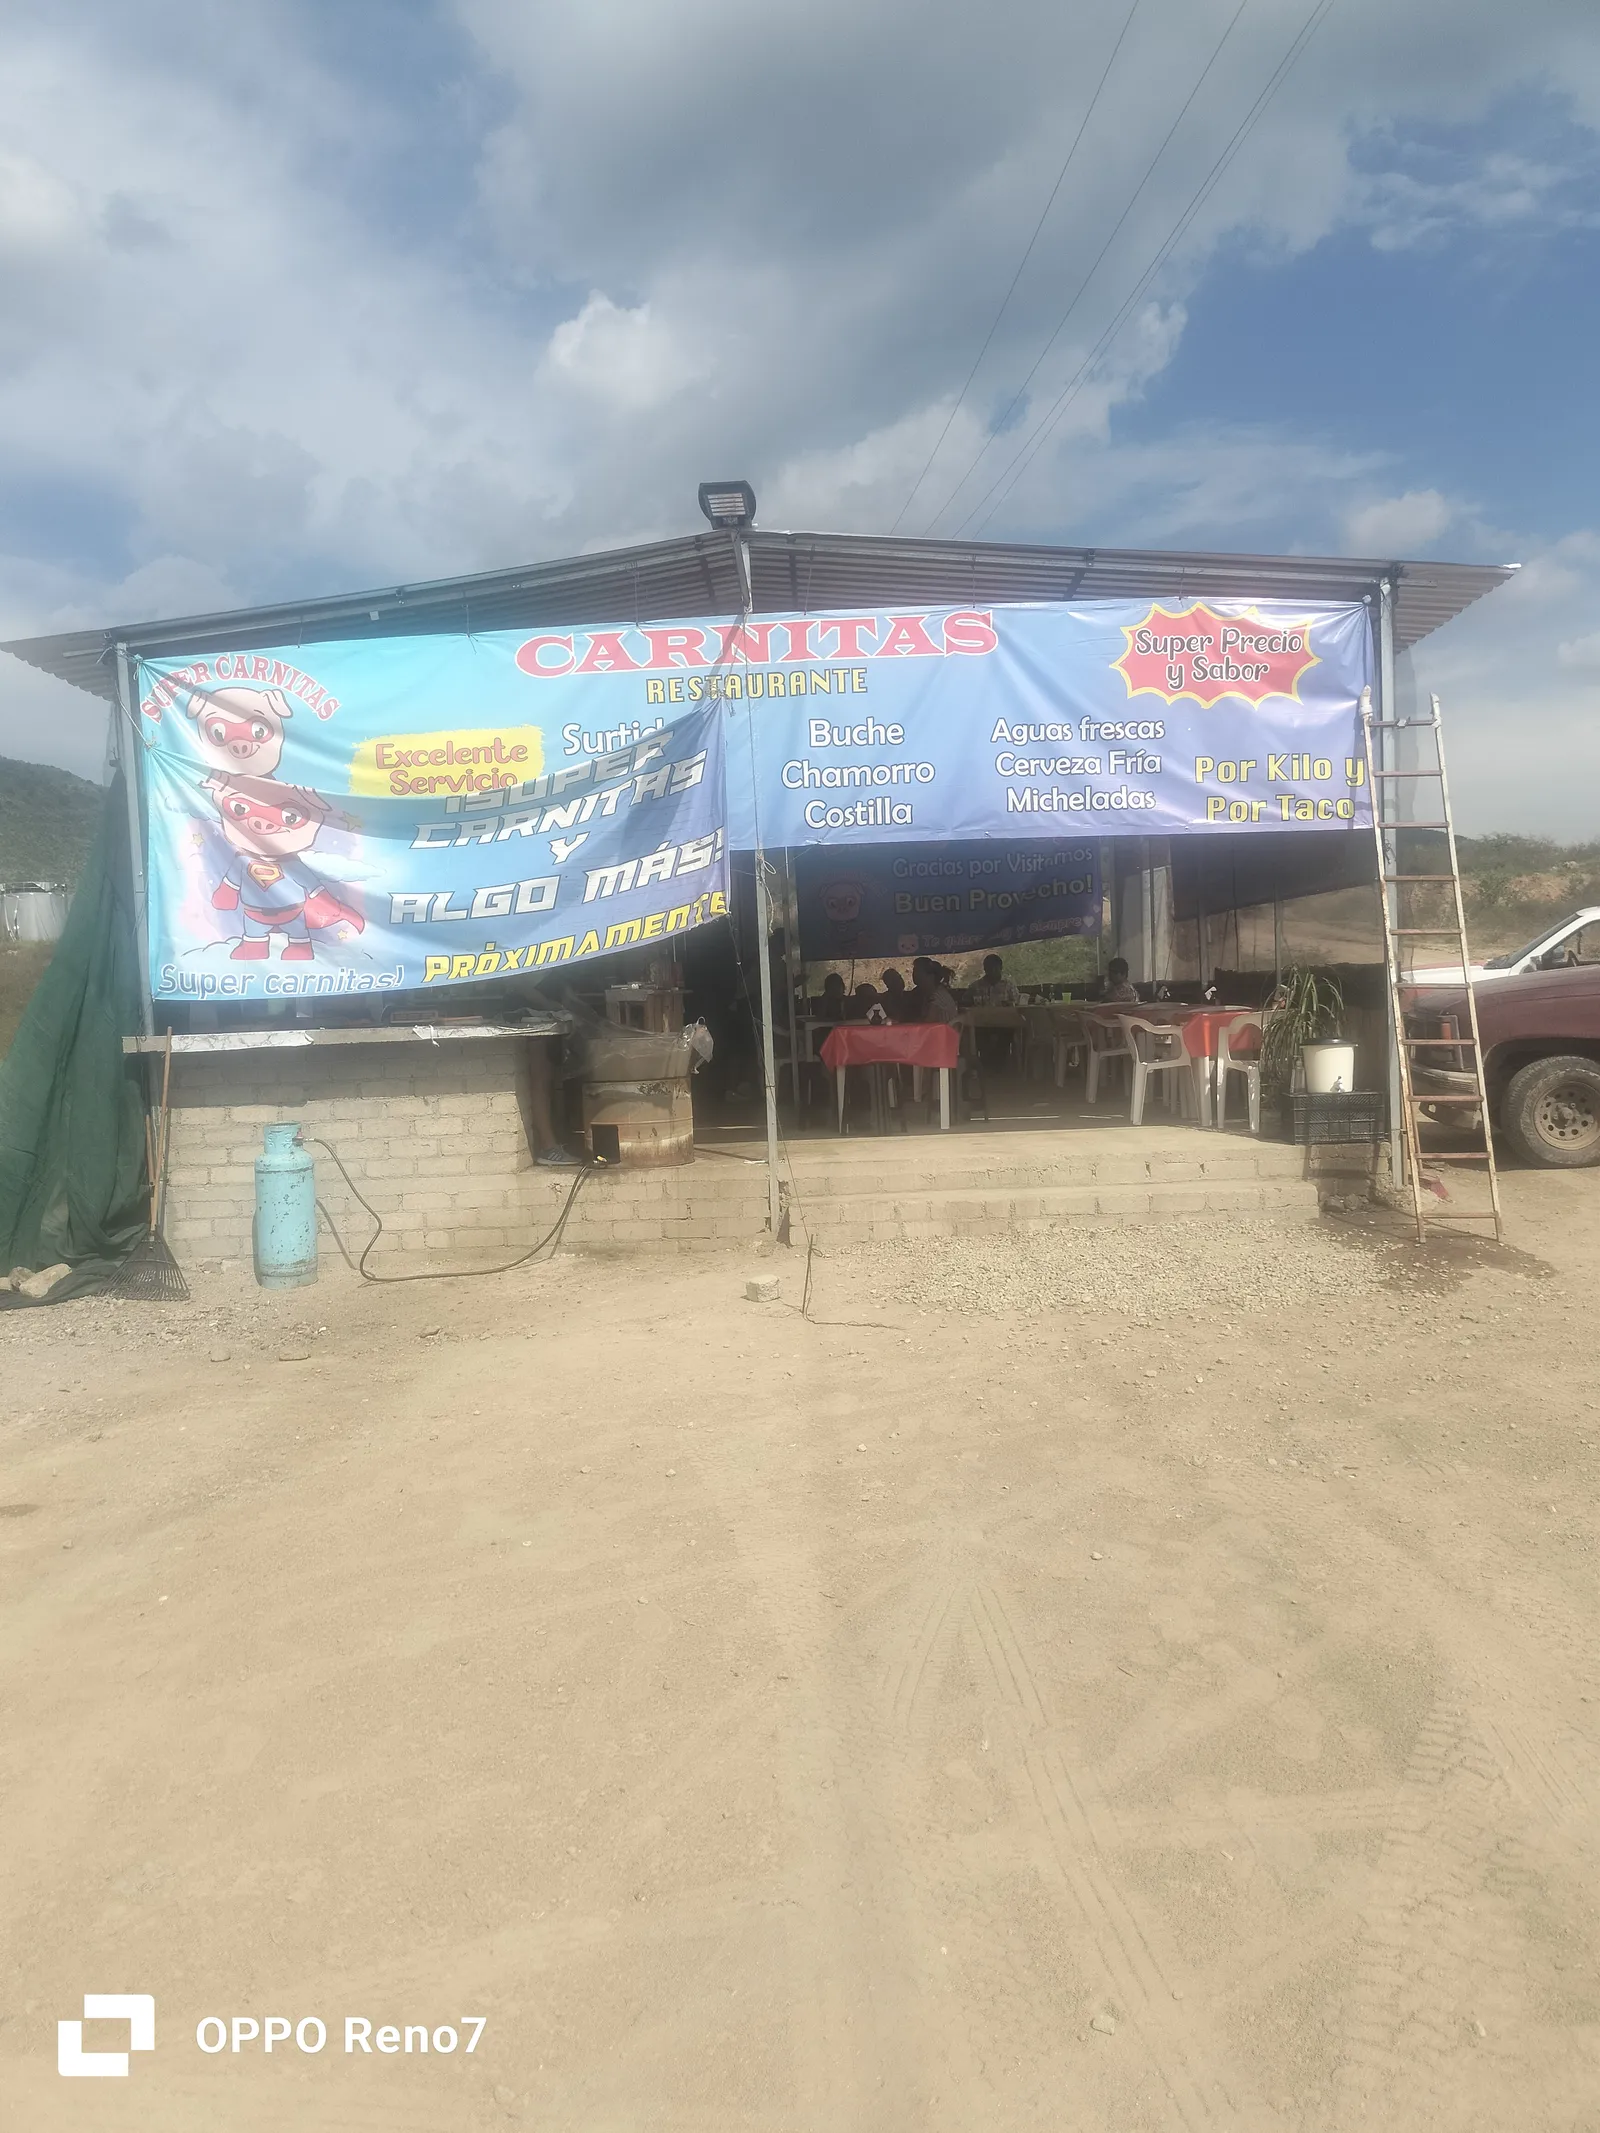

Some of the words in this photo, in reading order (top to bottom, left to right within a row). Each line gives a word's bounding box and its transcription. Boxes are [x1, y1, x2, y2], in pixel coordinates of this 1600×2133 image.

[515, 609, 999, 678] CARNITAS
[1134, 629, 1213, 662] Super
[1220, 627, 1302, 654] Precio
[140, 660, 213, 724] SUPER
[215, 652, 342, 722] CARNITAS
[646, 667, 868, 704] RESTAURANTE
[1166, 662, 1184, 690] y
[1191, 655, 1270, 682] Sabor
[808, 717, 905, 748] Buche
[990, 717, 1073, 746] Aguas
[1078, 715, 1165, 742] frescas
[375, 737, 528, 770] Excelente
[995, 752, 1102, 777] Cerveza
[1108, 749, 1162, 775] Fría
[1194, 755, 1257, 784] Por
[1266, 752, 1333, 782] Kilo
[1345, 757, 1365, 787] y
[389, 768, 518, 796] Servicio
[781, 759, 936, 789] Chamorro
[409, 749, 708, 849] CARNITAS
[804, 797, 913, 829] Costilla
[1006, 785, 1156, 813] Micheladas
[1206, 796, 1267, 823] Por
[1276, 794, 1355, 821] Taco
[549, 831, 589, 865] Y
[388, 875, 560, 924] ALGO
[582, 825, 725, 903] MÁS!
[893, 857, 963, 878] Gracias
[968, 858, 1002, 878] por
[894, 891, 960, 914] Buen
[422, 891, 727, 983] PRÓXIMAMENTE
[158, 964, 255, 999] Super
[264, 965, 404, 994] carnitas!
